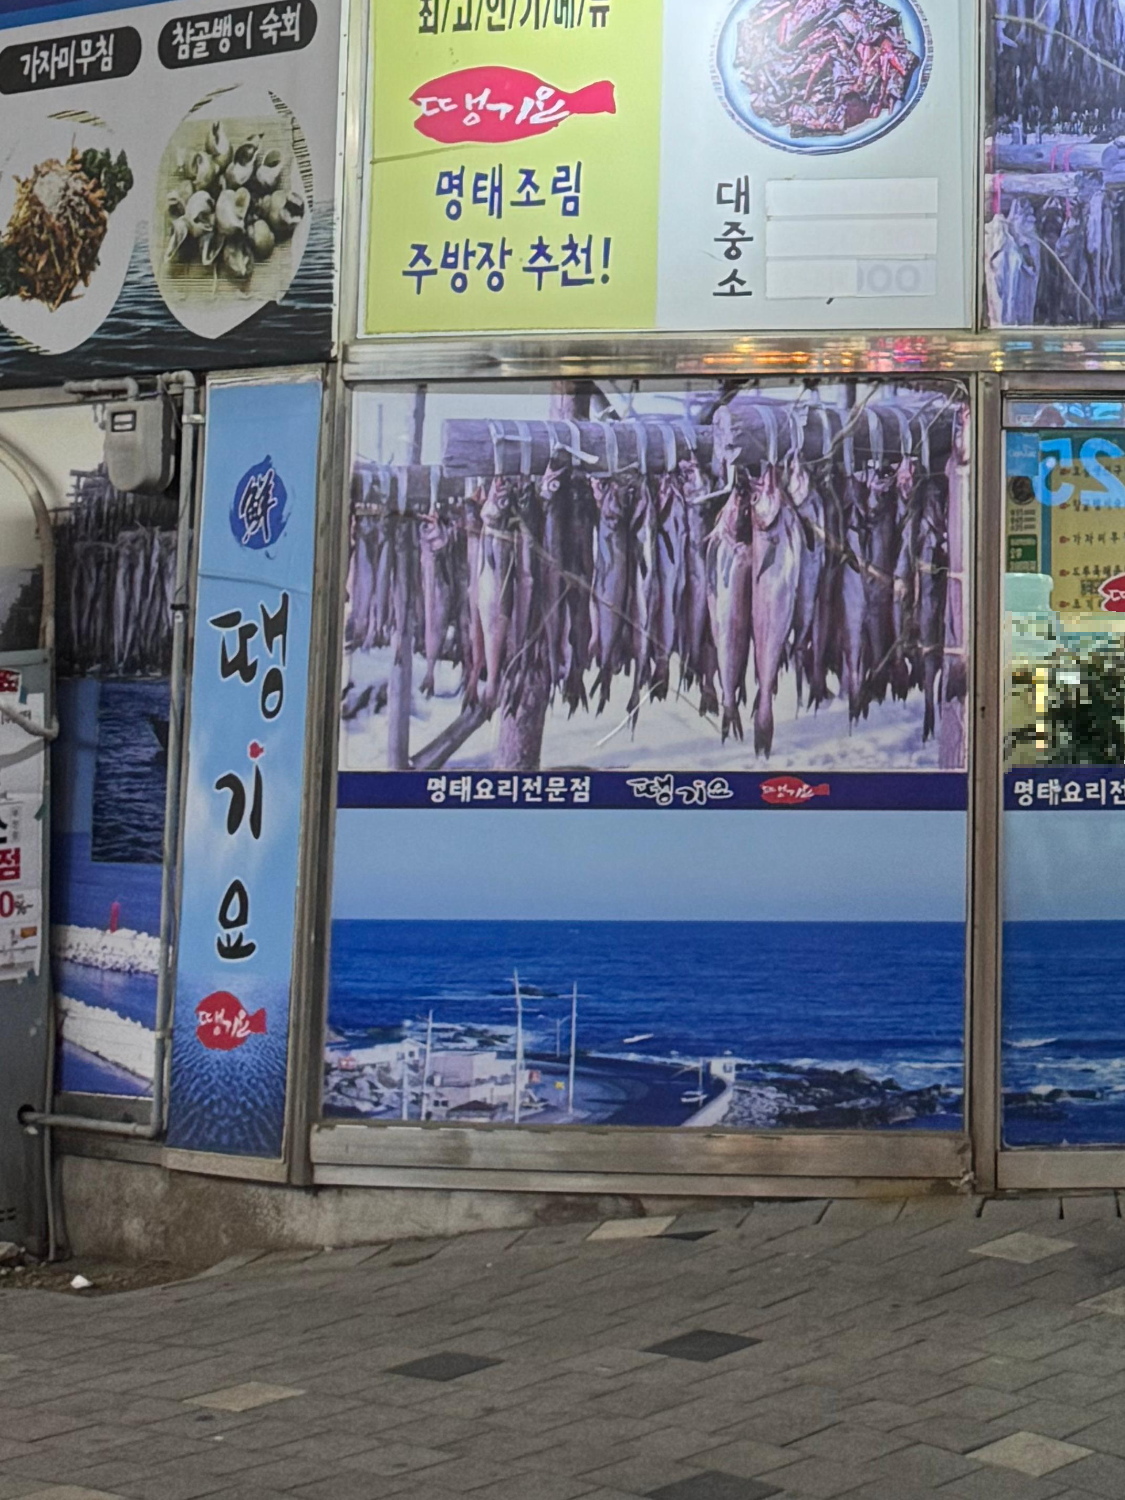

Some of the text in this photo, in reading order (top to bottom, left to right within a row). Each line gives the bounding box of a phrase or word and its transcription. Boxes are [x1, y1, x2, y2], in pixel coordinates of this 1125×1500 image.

[20, 34, 116, 84] 가자미무침
[171, 8, 254, 60] 참골뱅이
[435, 161, 583, 221] 명태조림
[716, 175, 751, 215] 대
[402, 234, 612, 296] 주방장 추천!
[713, 222, 754, 262] 중
[712, 269, 753, 297] 소
[208, 591, 290, 960] 땡기요
[426, 775, 591, 803] 명태요리전문점
[626, 774, 733, 806] 땡기요
